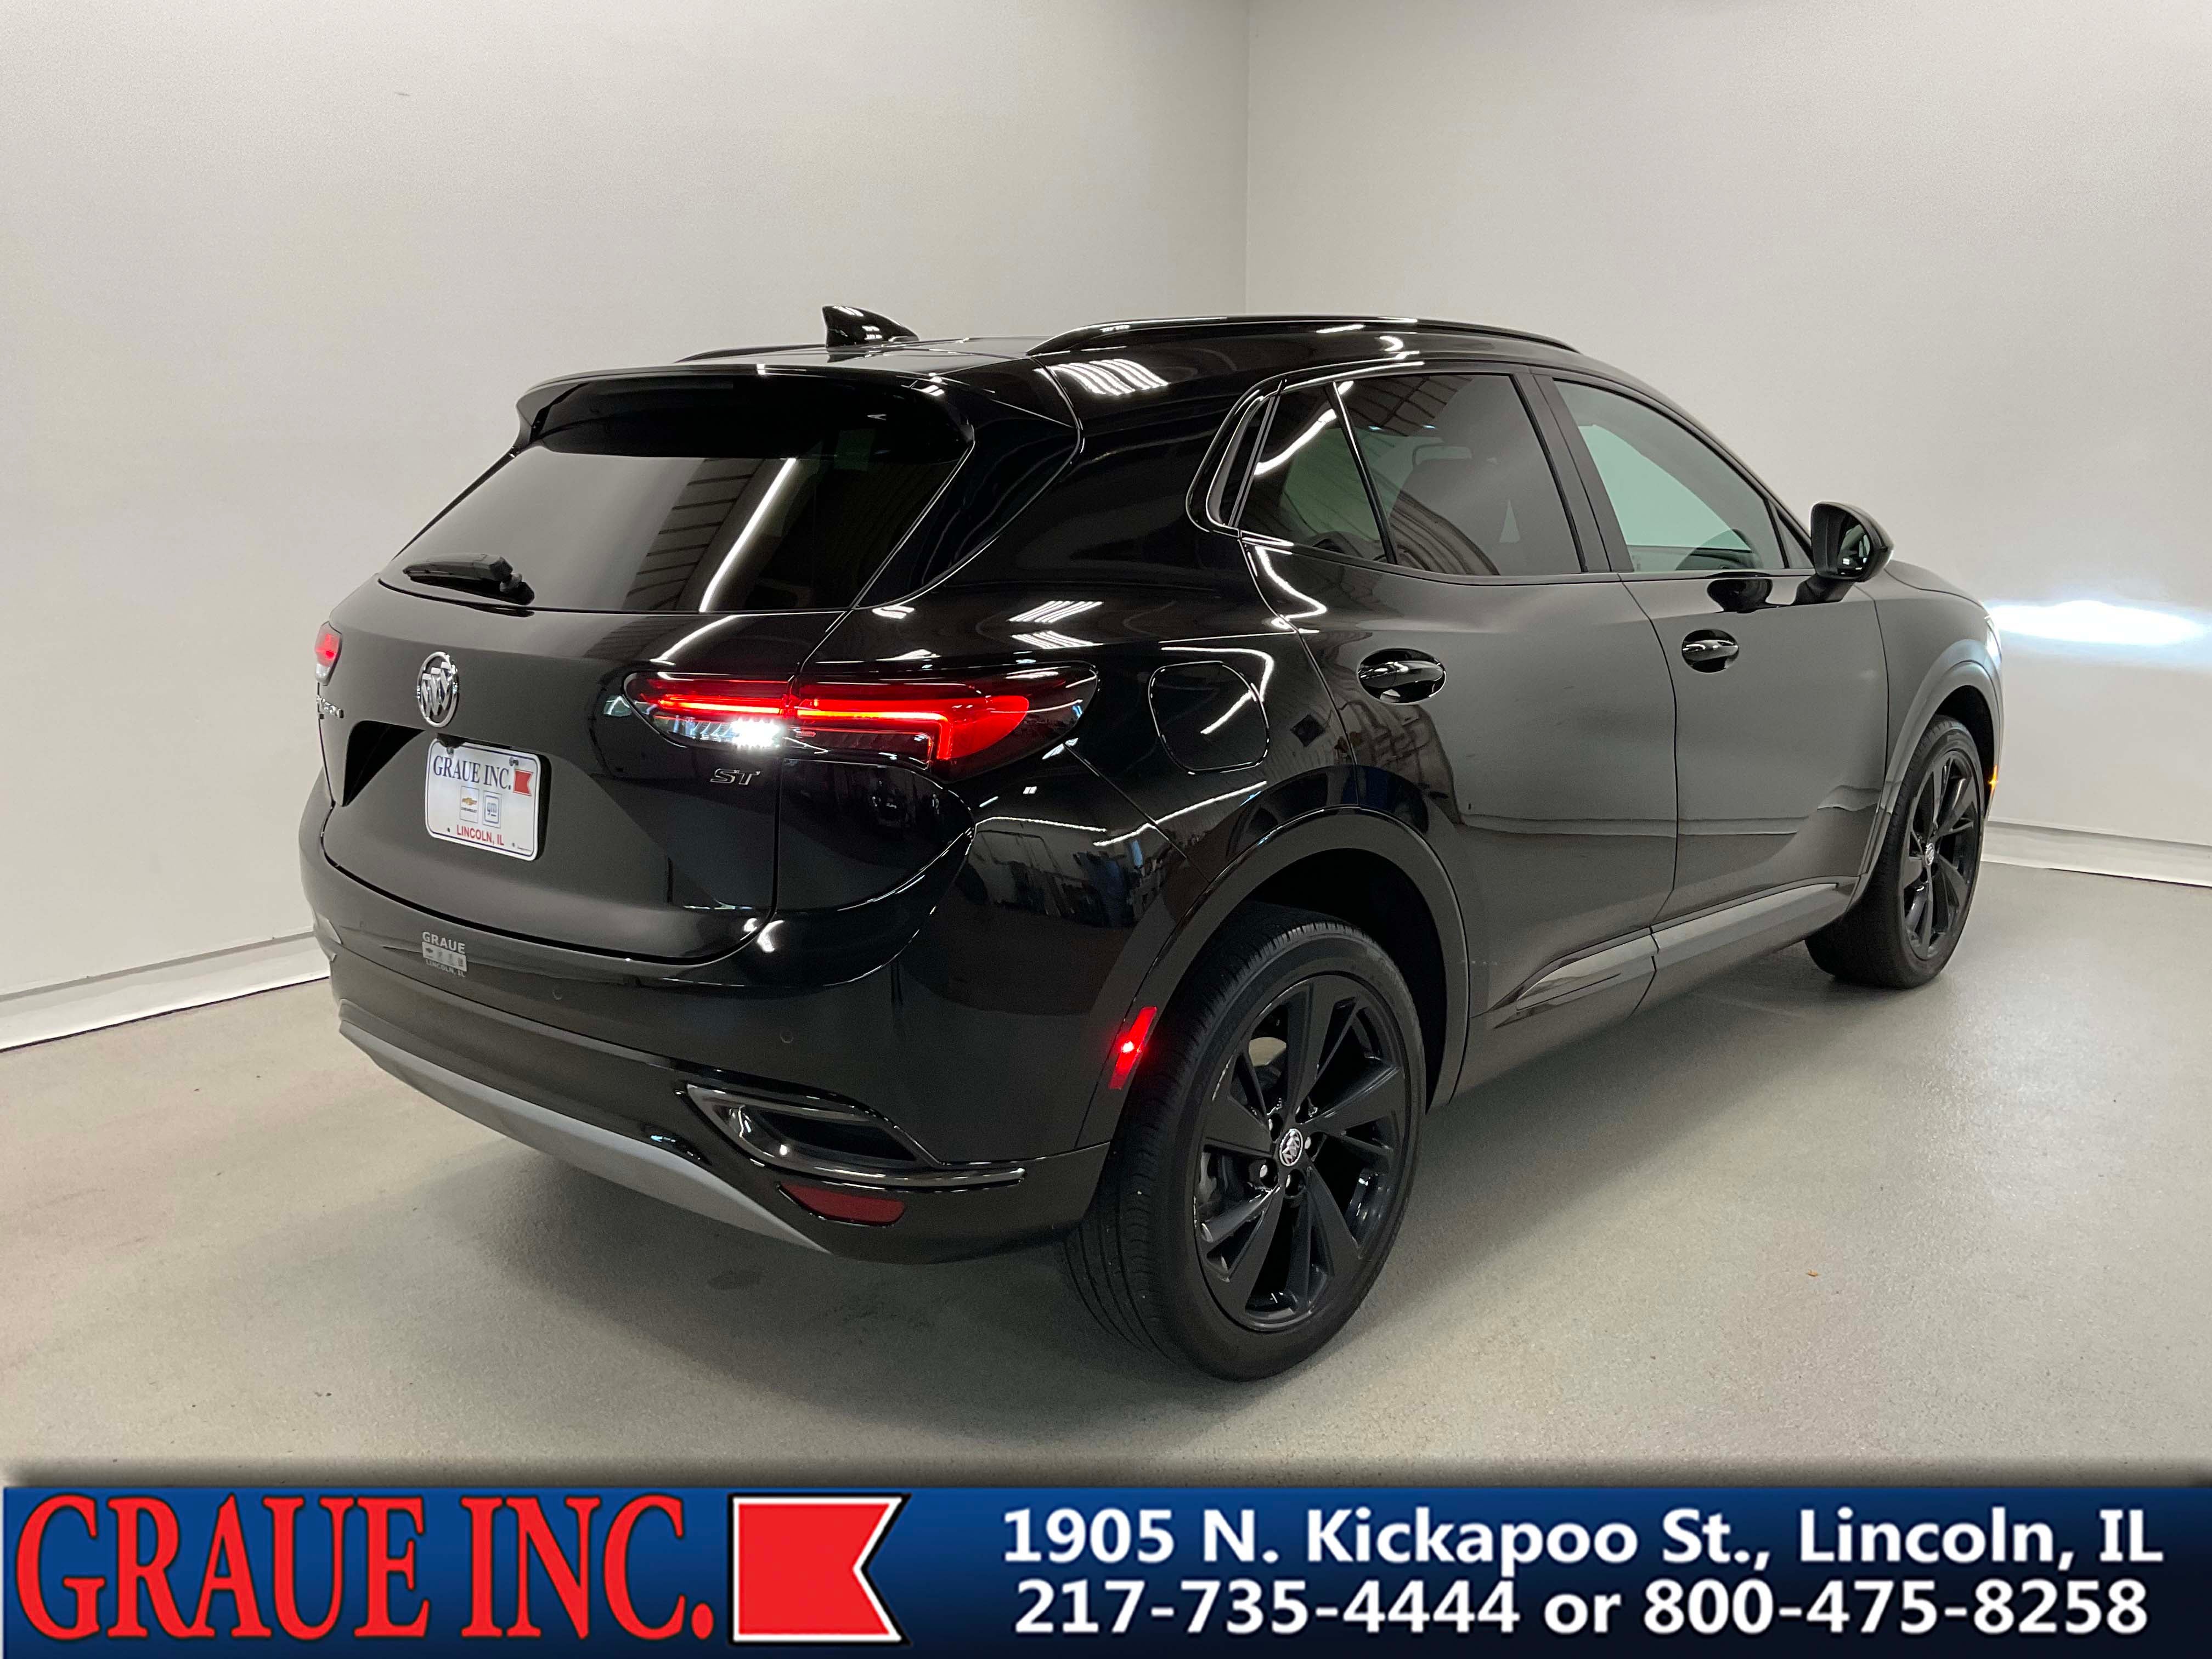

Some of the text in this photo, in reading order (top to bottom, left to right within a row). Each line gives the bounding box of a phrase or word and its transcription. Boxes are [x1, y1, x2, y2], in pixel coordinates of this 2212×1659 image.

[433, 755, 511, 791] GRAUE INC.
[710, 768, 761, 786] ST
[456, 824, 505, 845] LINCOLN, IL
[422, 931, 466, 954] GRAUE
